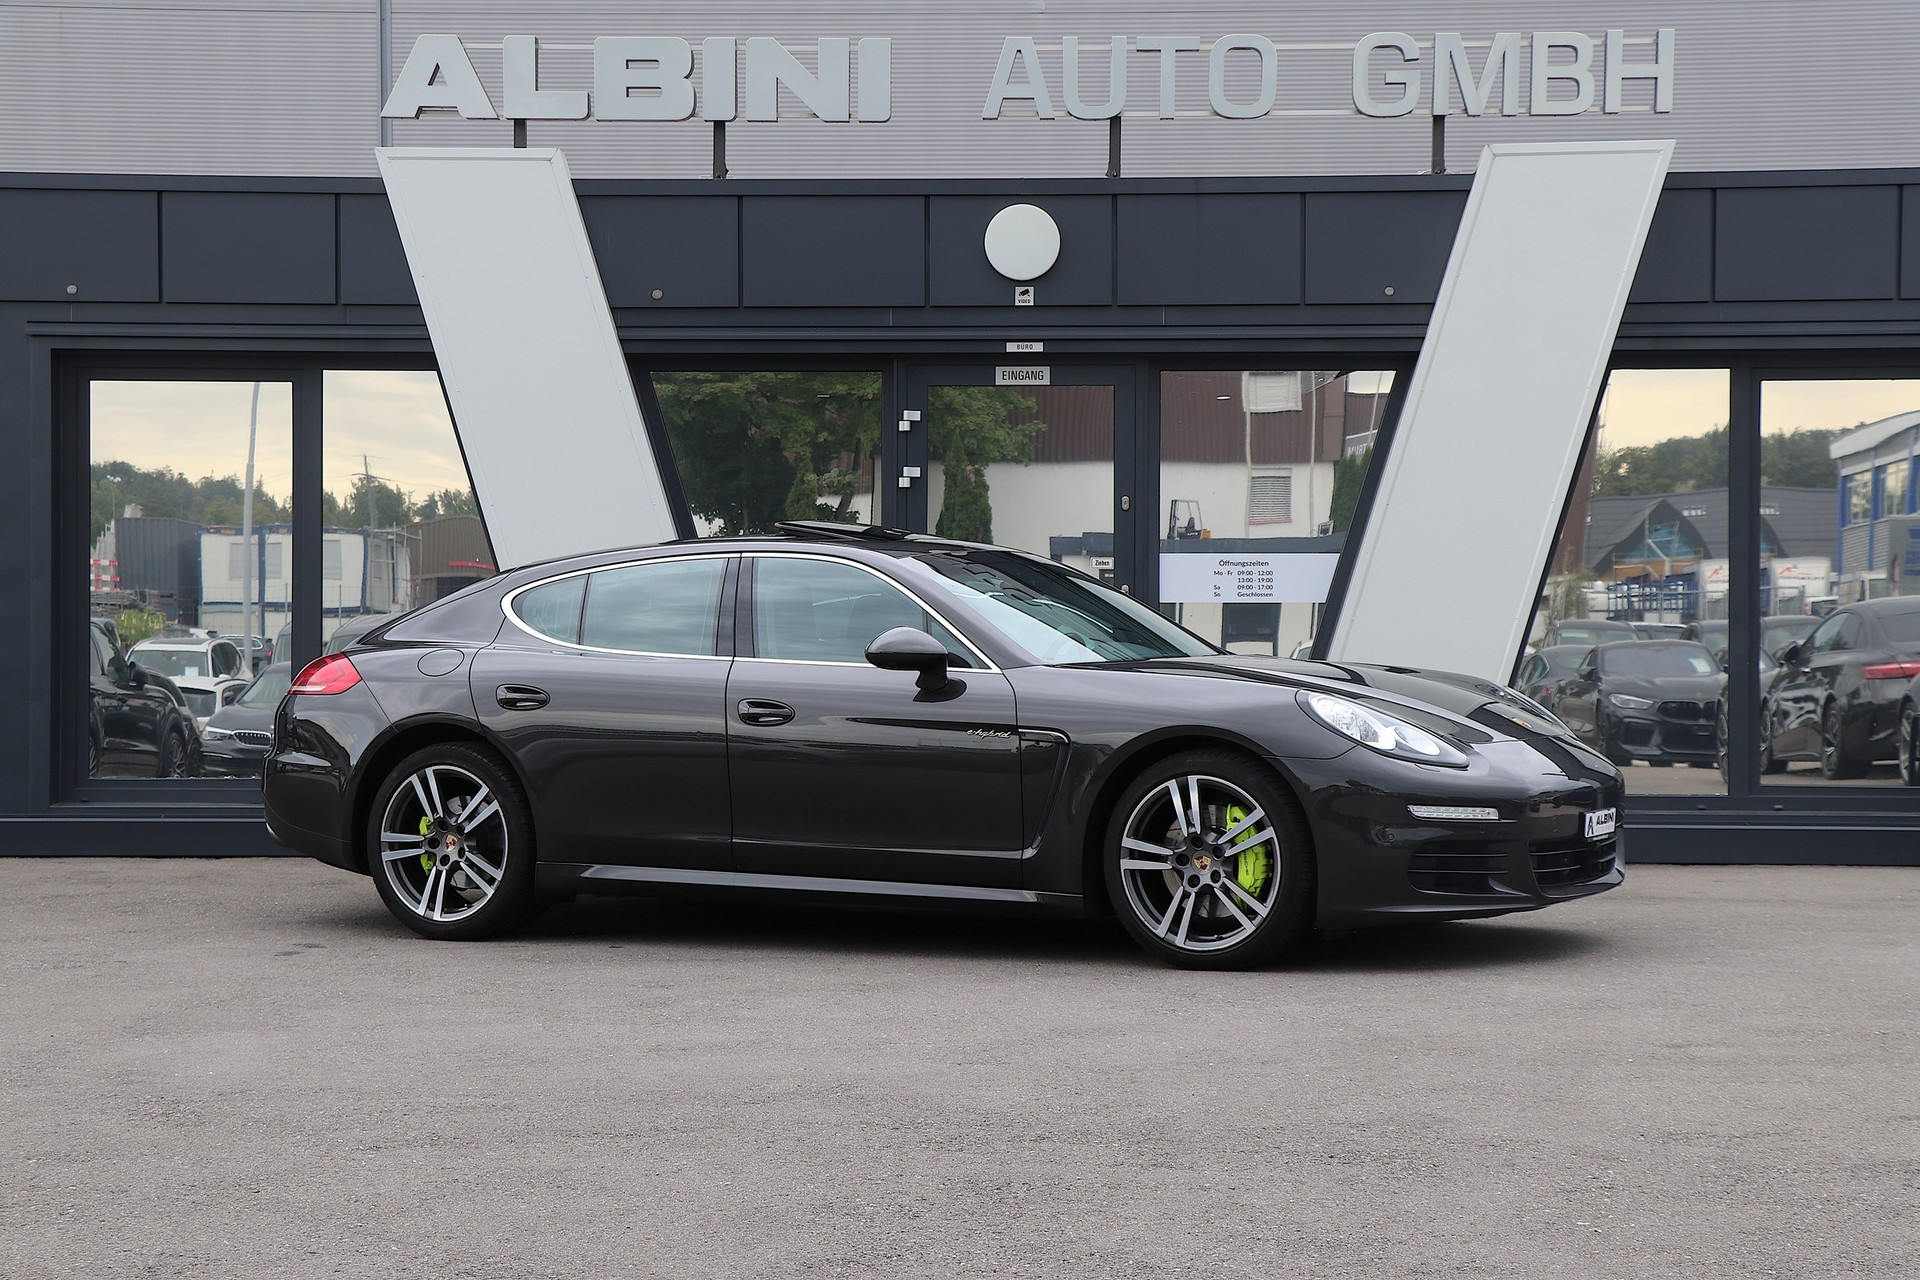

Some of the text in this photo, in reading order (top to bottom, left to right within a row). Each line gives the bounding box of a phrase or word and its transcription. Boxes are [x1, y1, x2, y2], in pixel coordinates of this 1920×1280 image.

[381, 28, 1676, 122] ALBINI AUTO GMBH
[1016, 342, 1034, 350] BÜRO
[1002, 370, 1044, 381] EINGANG
[1218, 559, 1269, 567] Öffnungszeiten
